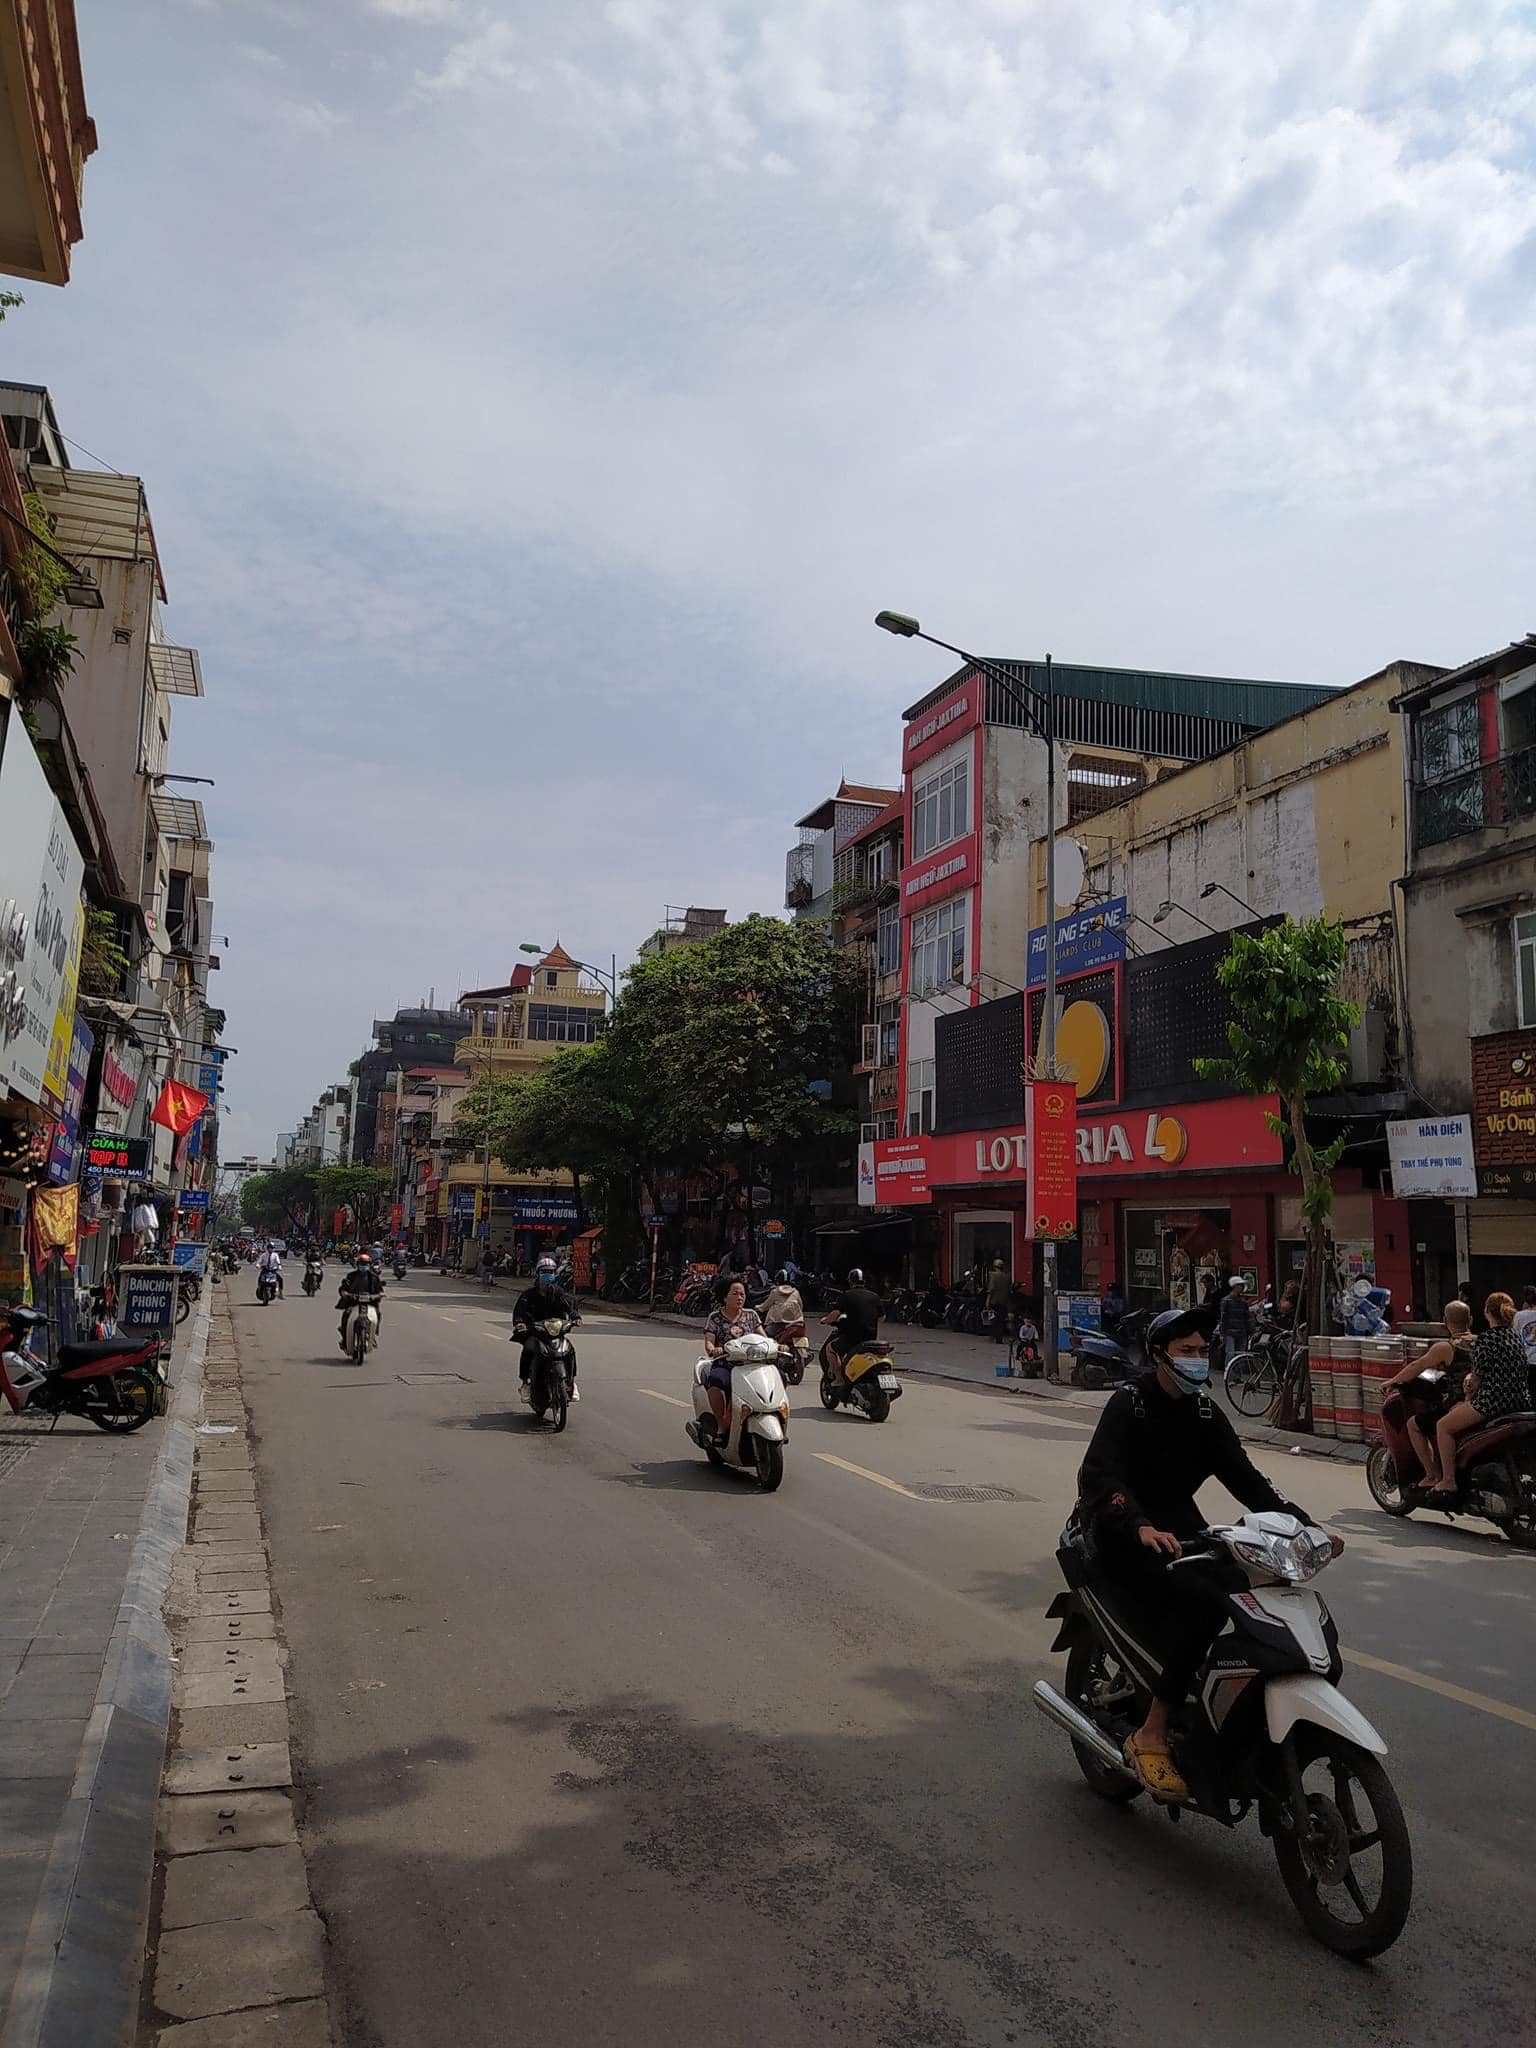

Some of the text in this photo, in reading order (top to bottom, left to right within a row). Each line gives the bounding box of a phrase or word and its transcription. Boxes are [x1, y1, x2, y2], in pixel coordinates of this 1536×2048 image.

[1500, 1087, 1535, 1108] Bánh
[976, 1124, 1133, 1172] LOTRIA
[1217, 1659, 1248, 1667] HONDA
